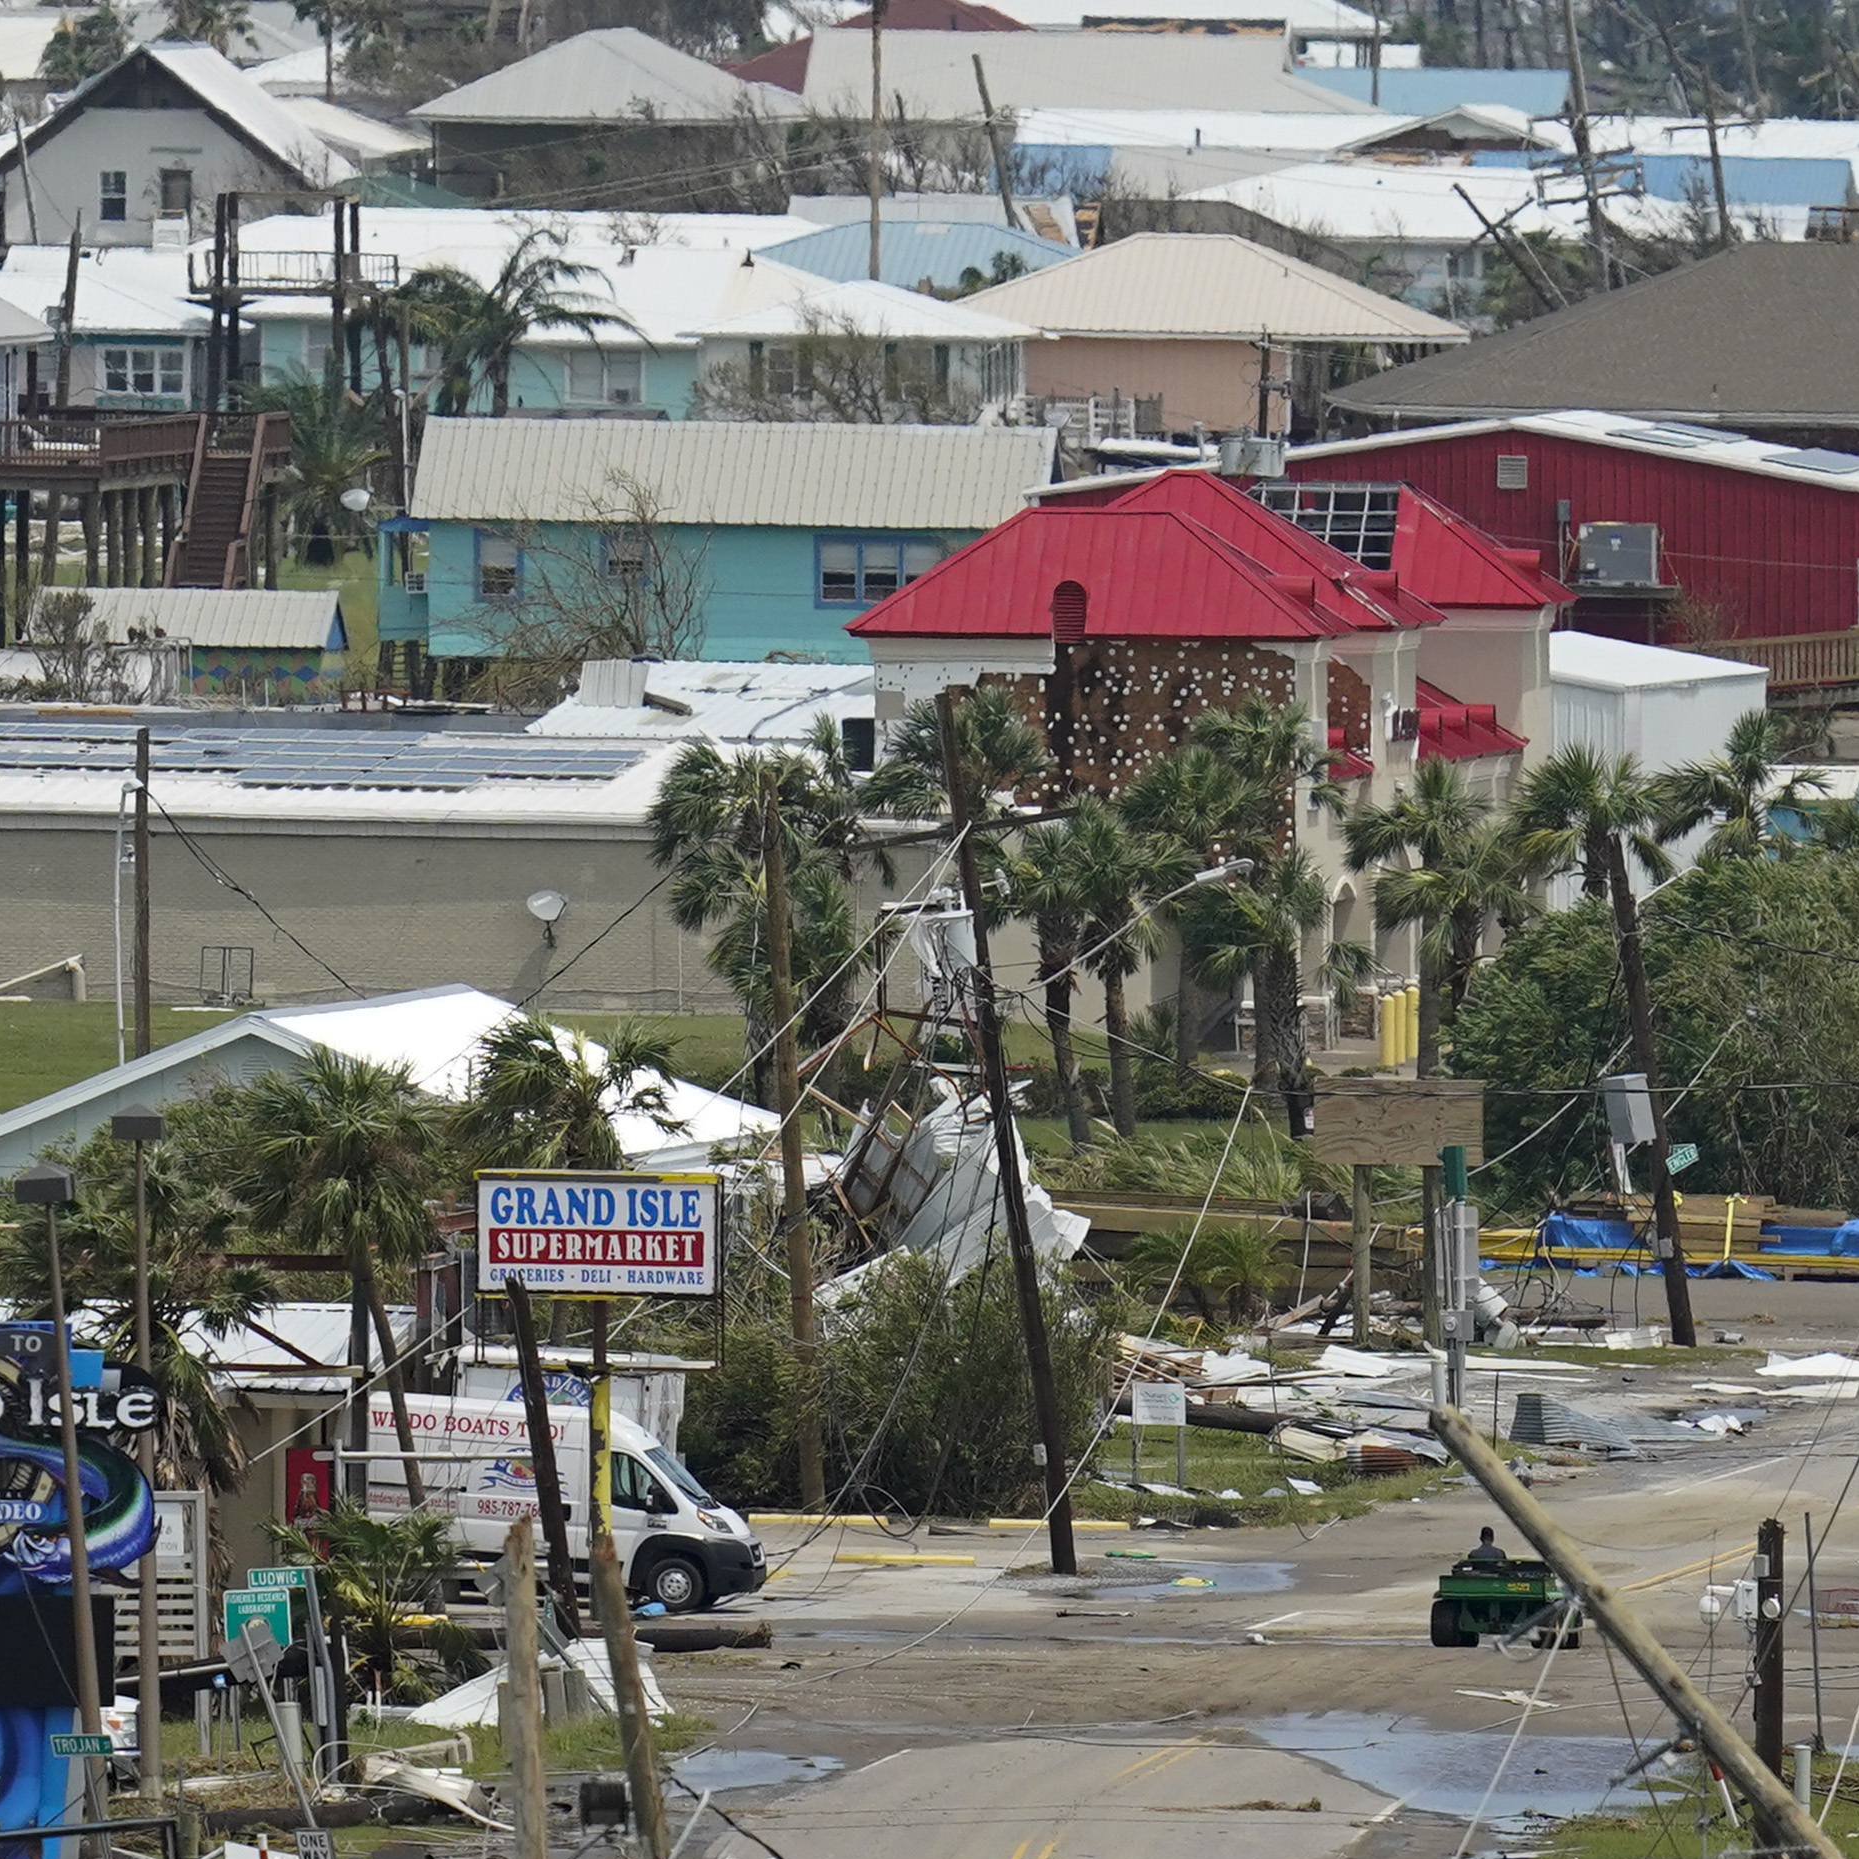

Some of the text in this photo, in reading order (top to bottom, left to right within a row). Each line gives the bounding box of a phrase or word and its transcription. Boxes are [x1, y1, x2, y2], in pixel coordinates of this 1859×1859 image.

[491, 1187, 701, 1228] GRAND ISLE
[497, 1232, 697, 1262] SUPERMARKET
[490, 1268, 705, 1285] GROCERIES DELI HARDWARE
[10, 1333, 42, 1354] TO
[408, 1413, 438, 1431] DO
[444, 1416, 511, 1437] BOATS
[516, 1421, 565, 1441] TO!
[250, 1570, 297, 1586] LUDWIG
[257, 1592, 287, 1603] RESEARCH
[237, 1603, 277, 1615] LABORATORY
[53, 1737, 101, 1753] TROJAN
[300, 1834, 327, 1849] ONE
